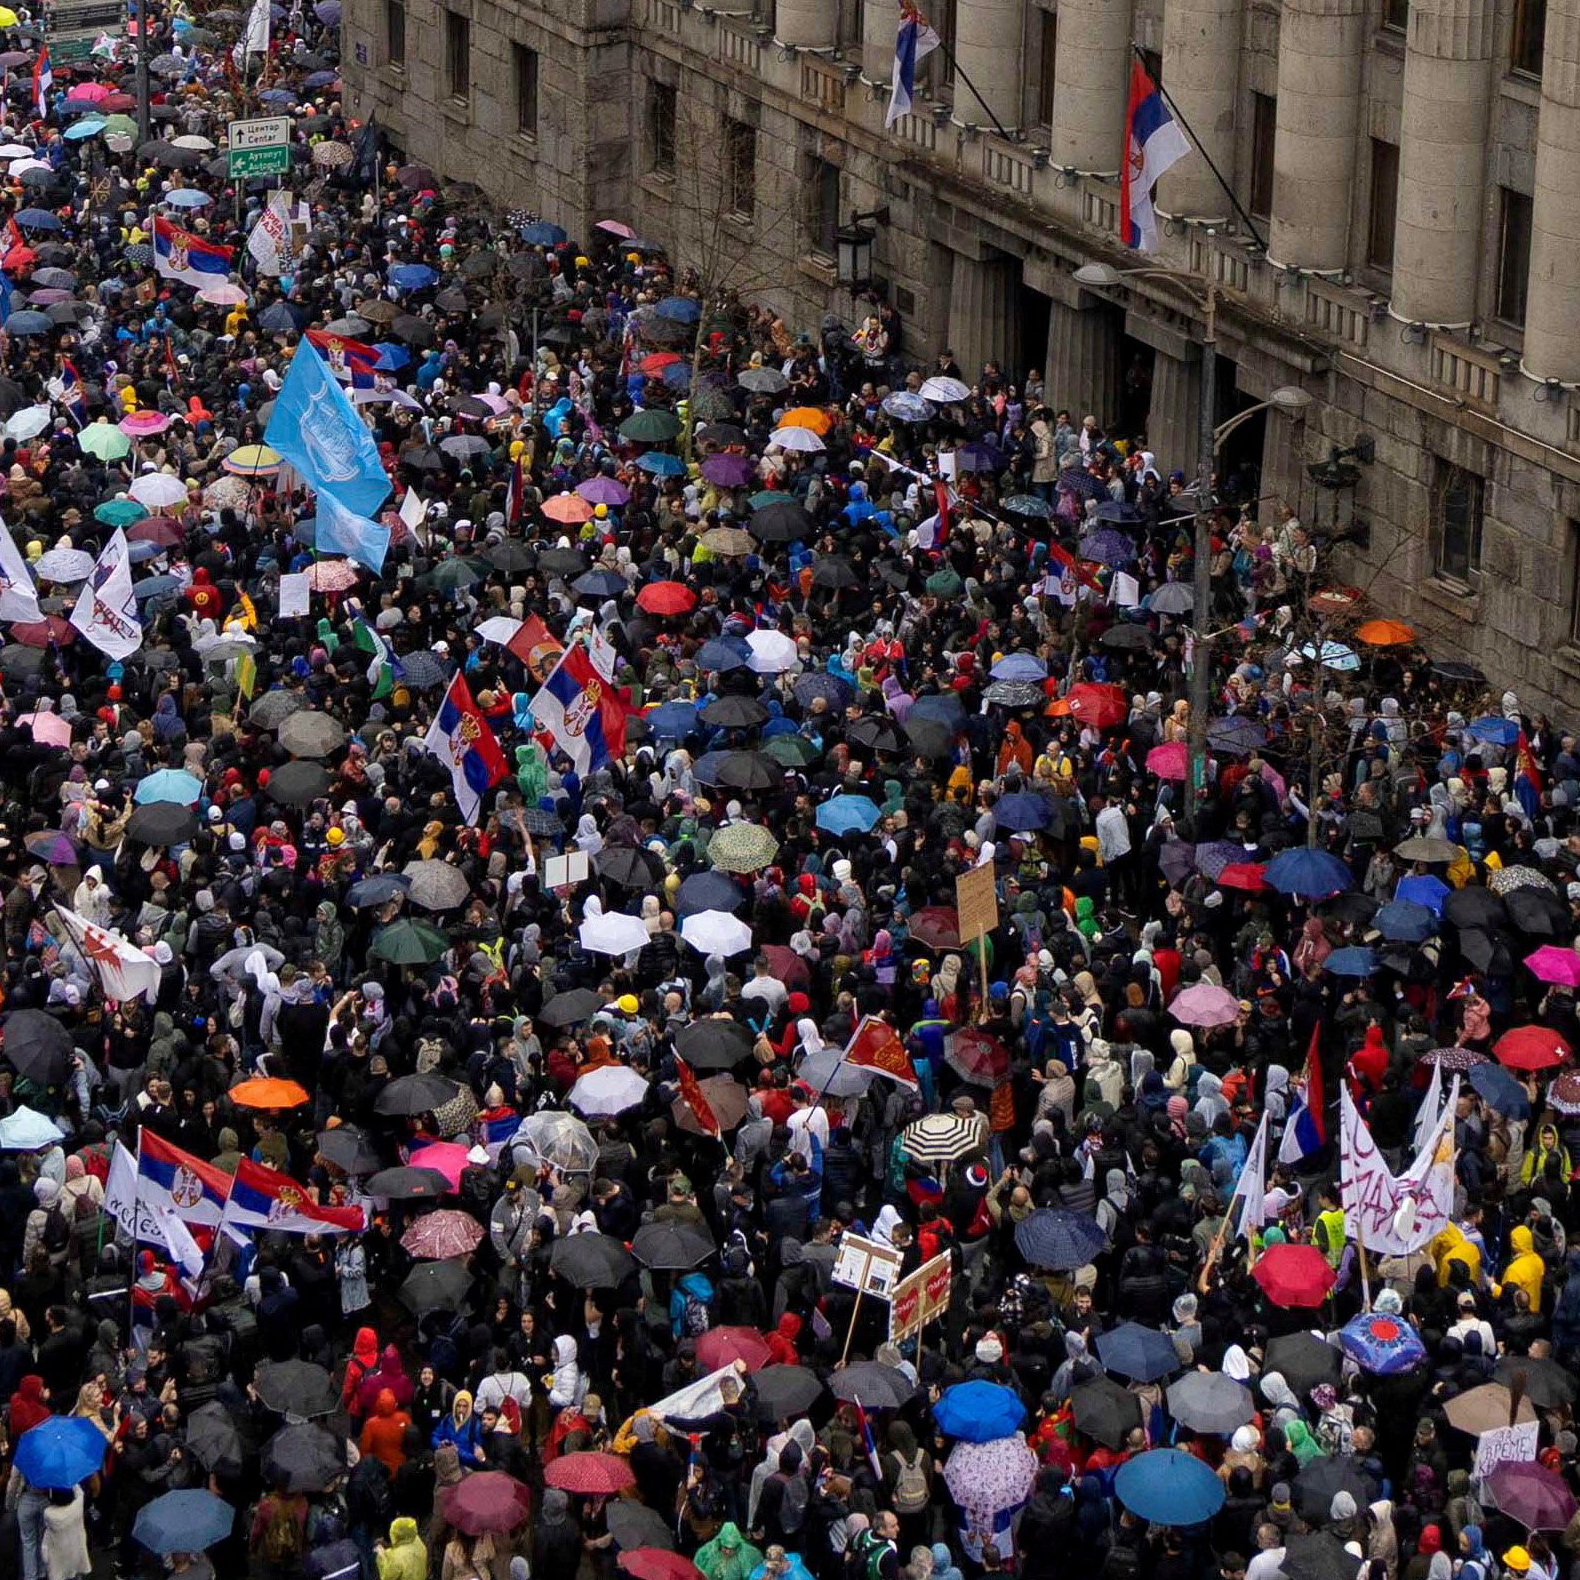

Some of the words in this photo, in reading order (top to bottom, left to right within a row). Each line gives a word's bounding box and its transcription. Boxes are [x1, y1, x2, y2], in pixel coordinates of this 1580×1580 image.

[247, 124, 280, 134] Центар
[248, 134, 276, 144] Centar
[249, 150, 283, 162] Аутопут
[249, 160, 281, 171] Autoput
